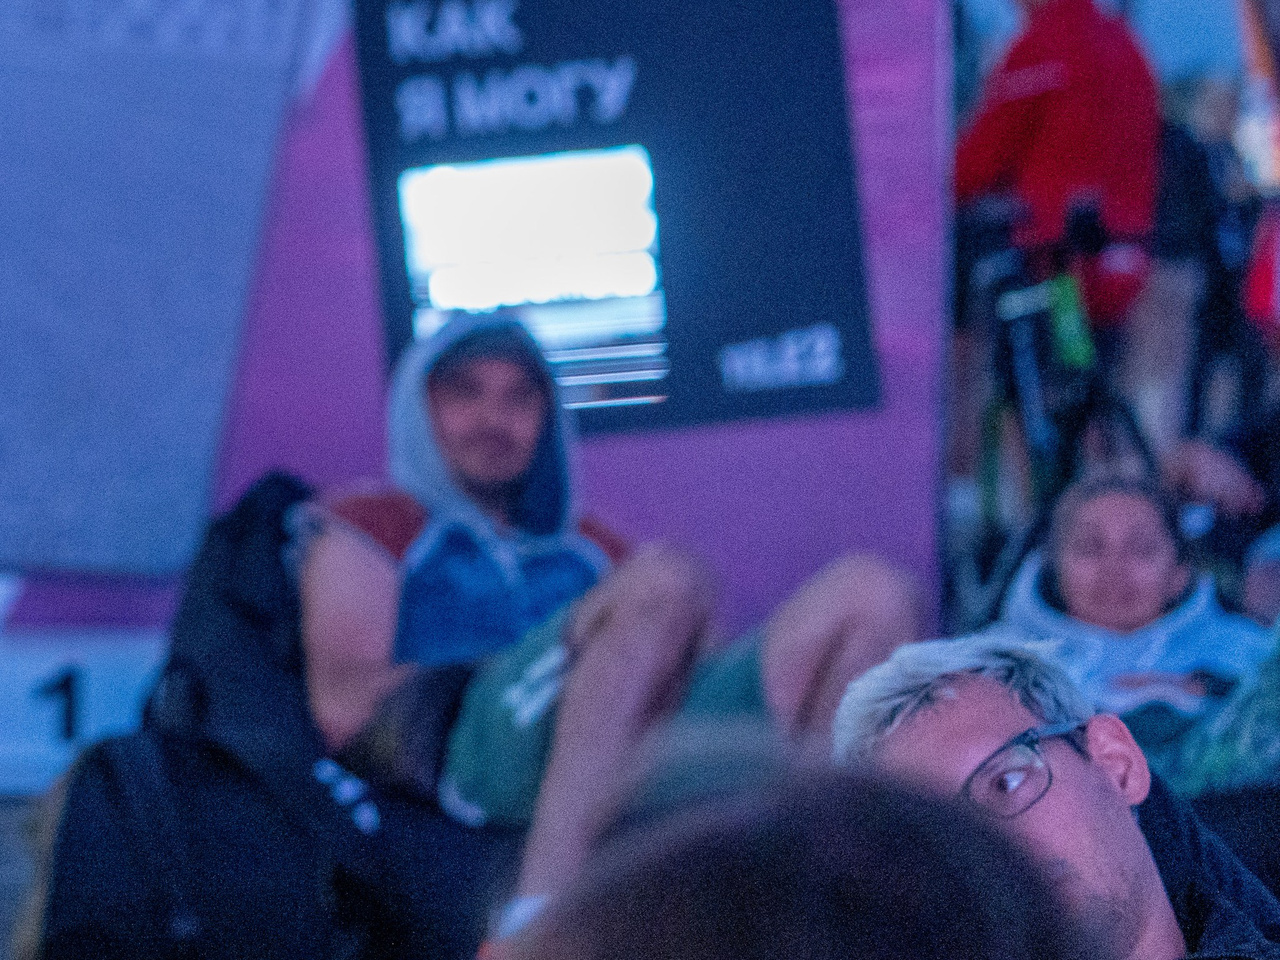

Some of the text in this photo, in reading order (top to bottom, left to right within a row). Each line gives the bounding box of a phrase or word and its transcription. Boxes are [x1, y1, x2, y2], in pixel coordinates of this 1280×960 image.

[397, 57, 636, 138] Я МОГУ
[33, 666, 81, 742] 1
